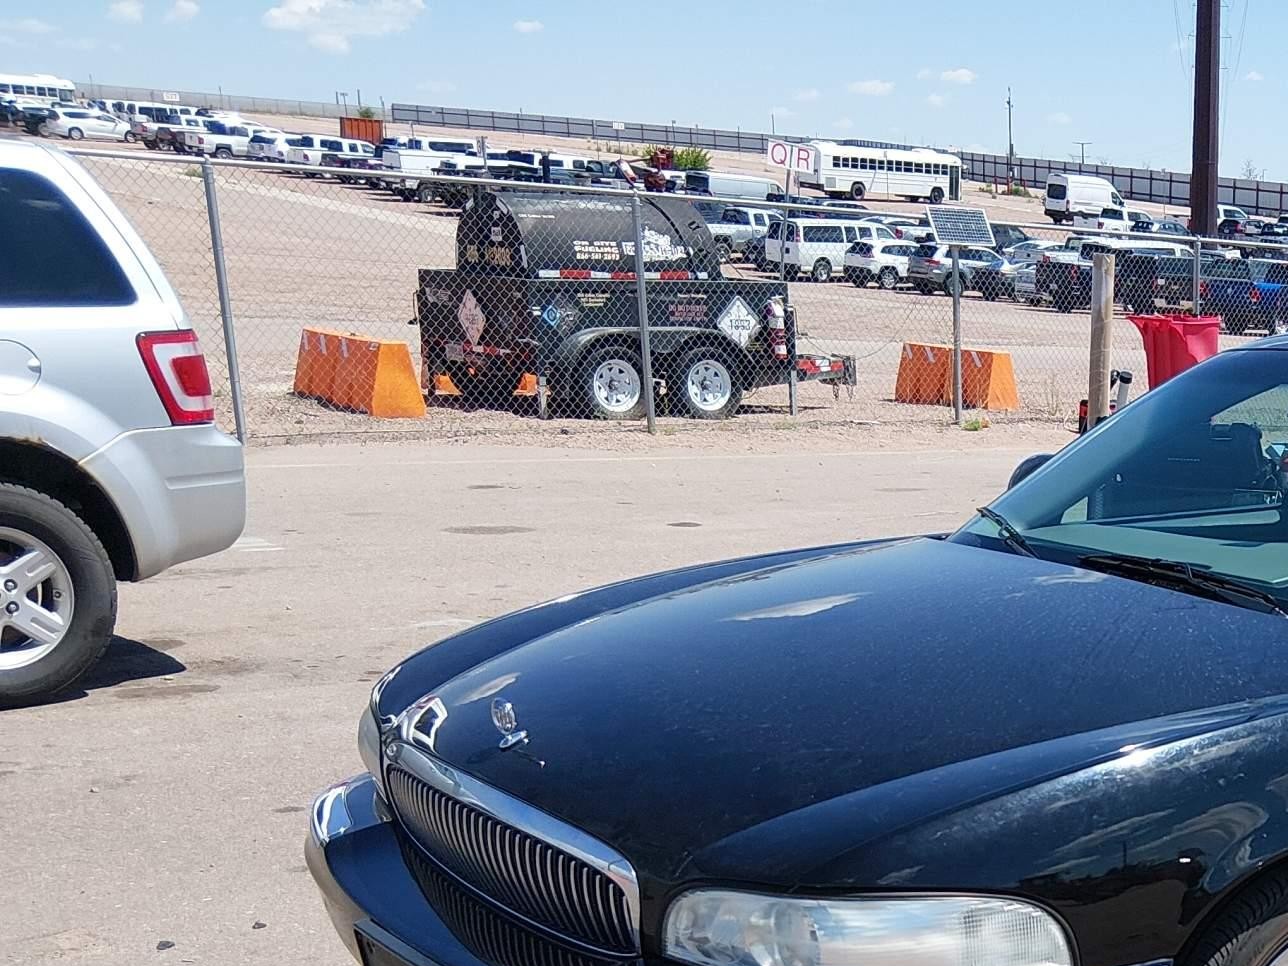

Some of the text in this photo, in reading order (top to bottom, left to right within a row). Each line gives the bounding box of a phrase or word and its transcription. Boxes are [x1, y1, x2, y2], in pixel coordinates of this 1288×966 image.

[771, 143, 787, 166] Q
[797, 149, 809, 170] R
[574, 245, 619, 254] FUELING
